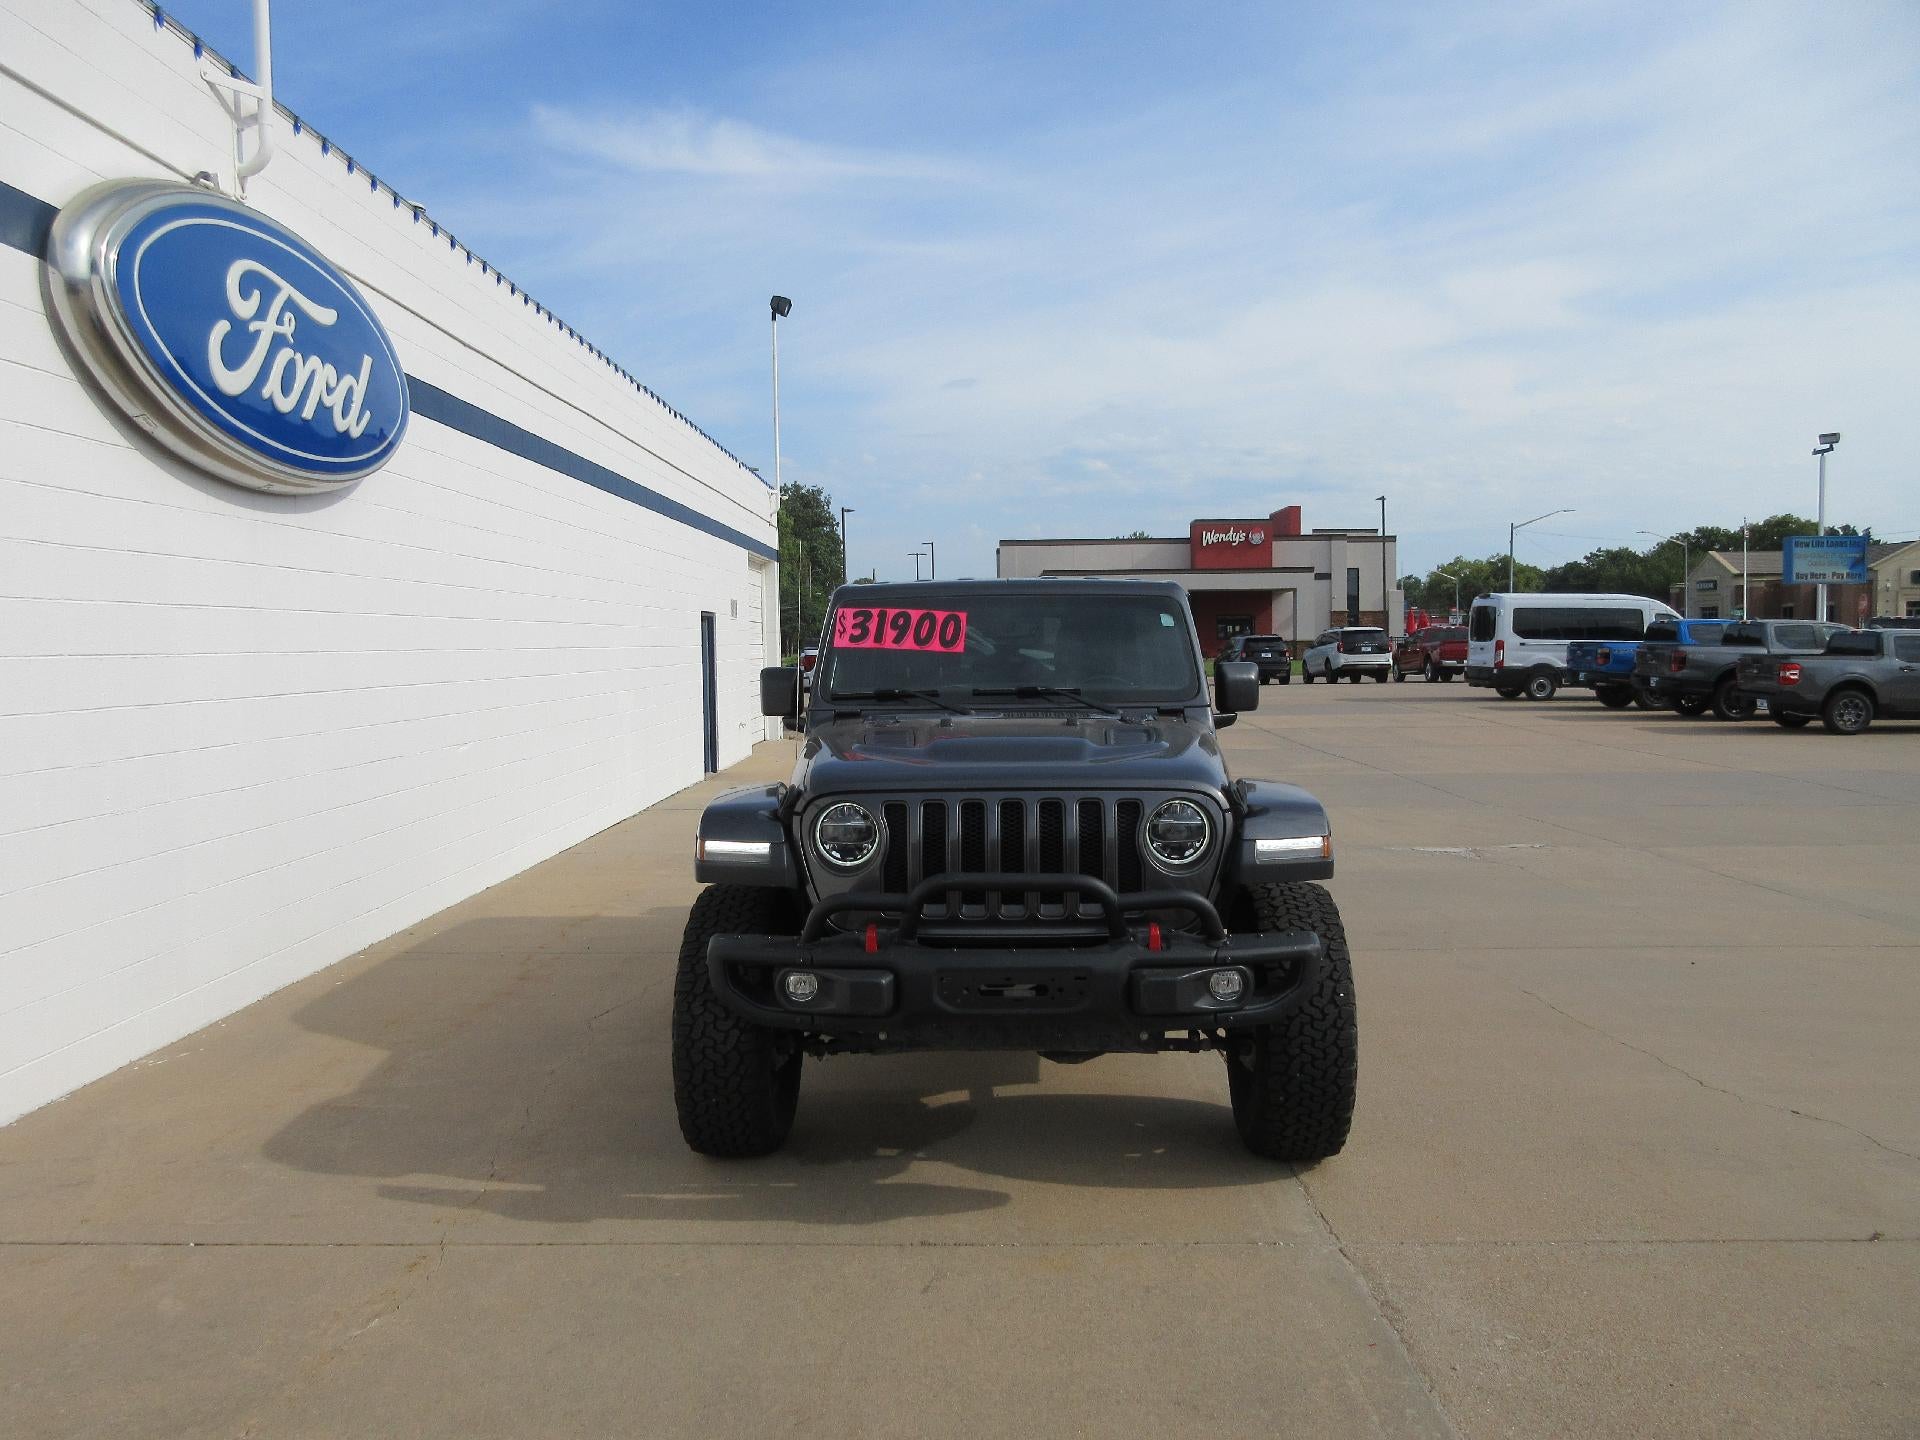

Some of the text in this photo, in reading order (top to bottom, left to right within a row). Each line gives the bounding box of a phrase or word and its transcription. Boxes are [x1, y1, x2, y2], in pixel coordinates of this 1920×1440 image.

[208, 259, 373, 439] Ford
[1202, 527, 1246, 546] Wendy's
[1795, 572, 1808, 580] Buy
[1809, 572, 1826, 580] Here
[1831, 572, 1844, 580] Pay
[1845, 572, 1863, 580] Here
[838, 609, 962, 649] $31900
